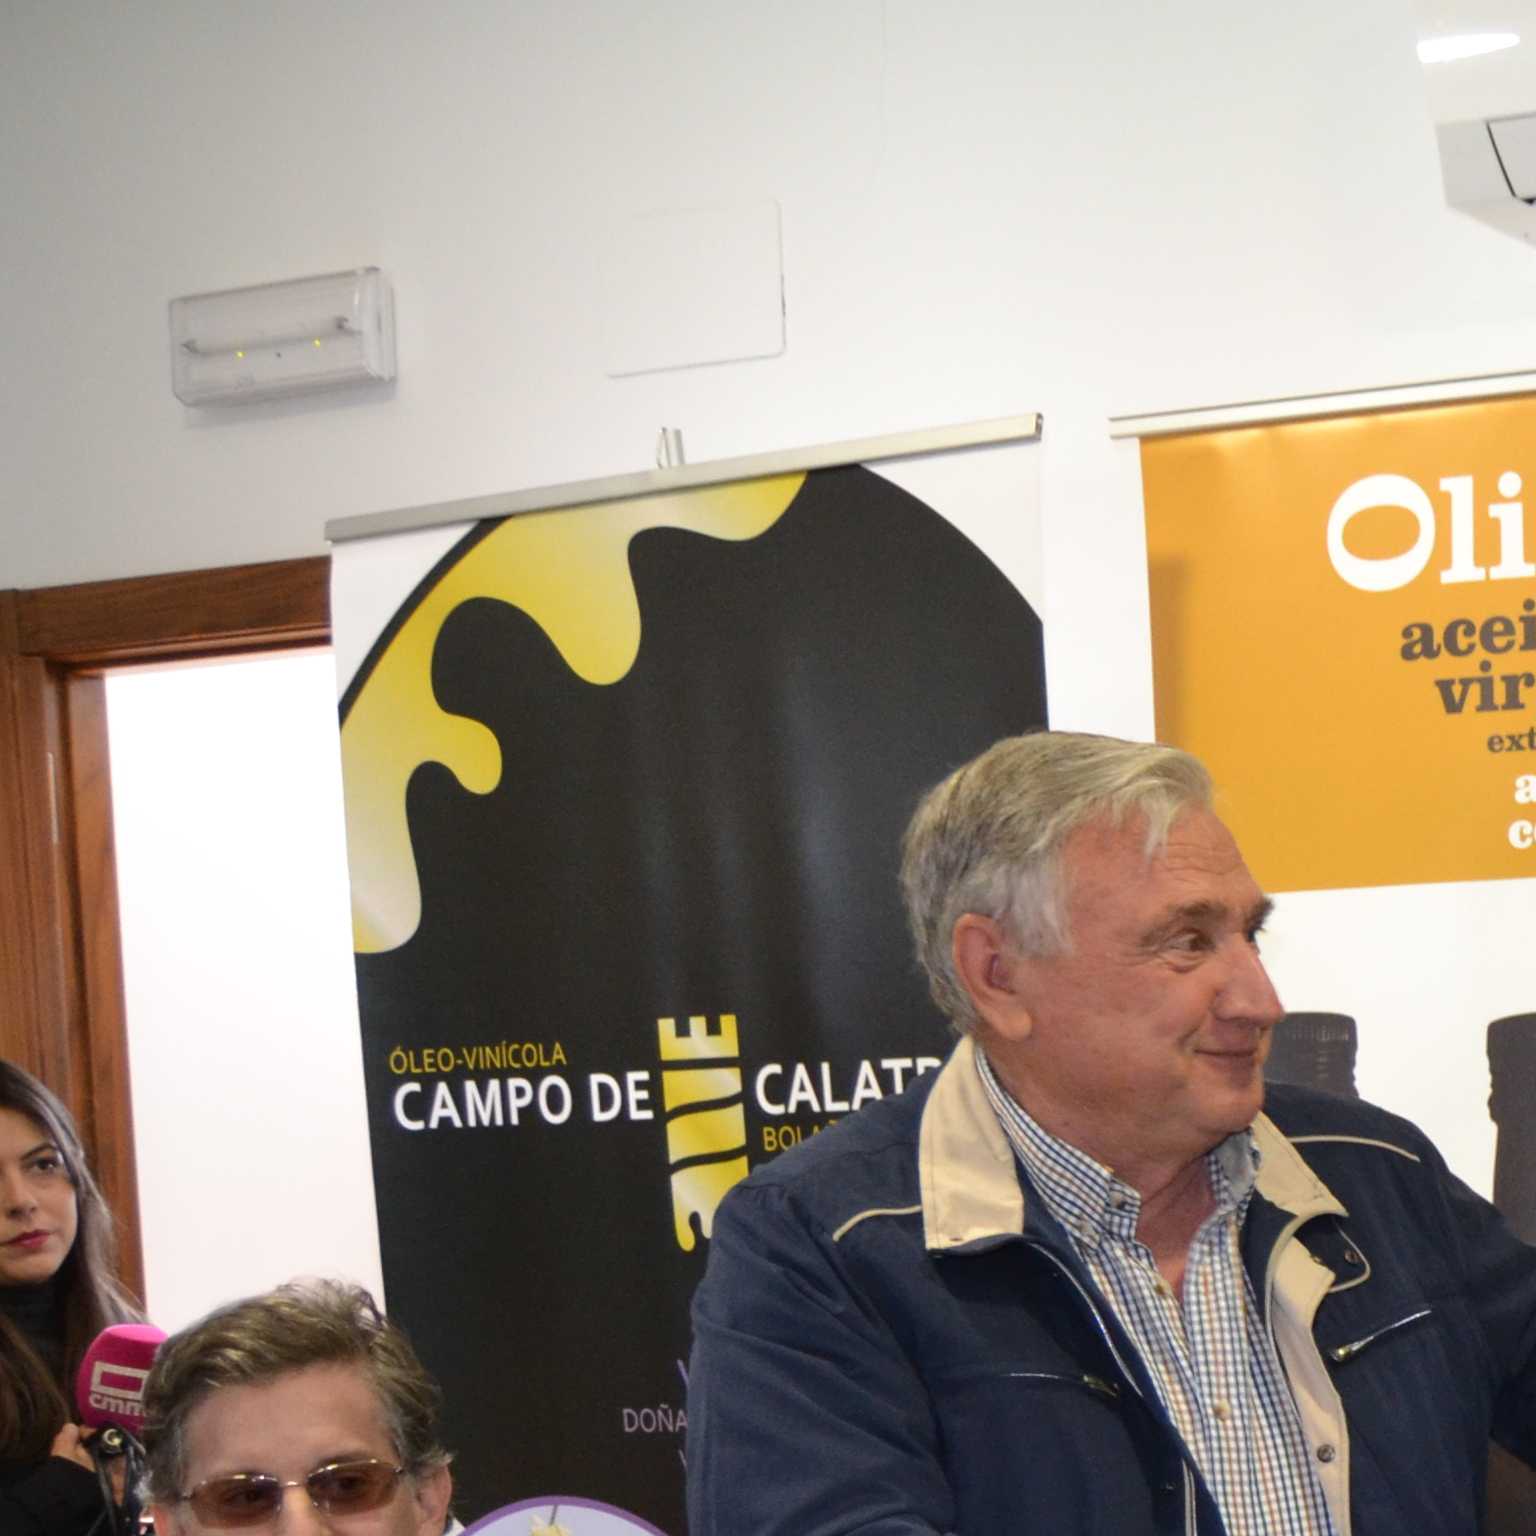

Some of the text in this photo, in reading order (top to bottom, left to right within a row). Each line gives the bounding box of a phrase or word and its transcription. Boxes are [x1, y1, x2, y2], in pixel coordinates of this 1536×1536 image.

[389, 1041, 567, 1075] ÓLEO-VINÍCOLA
[393, 1077, 572, 1131] CAMPO
[590, 1071, 654, 1122] DE
[622, 1404, 688, 1432] DOÑA
